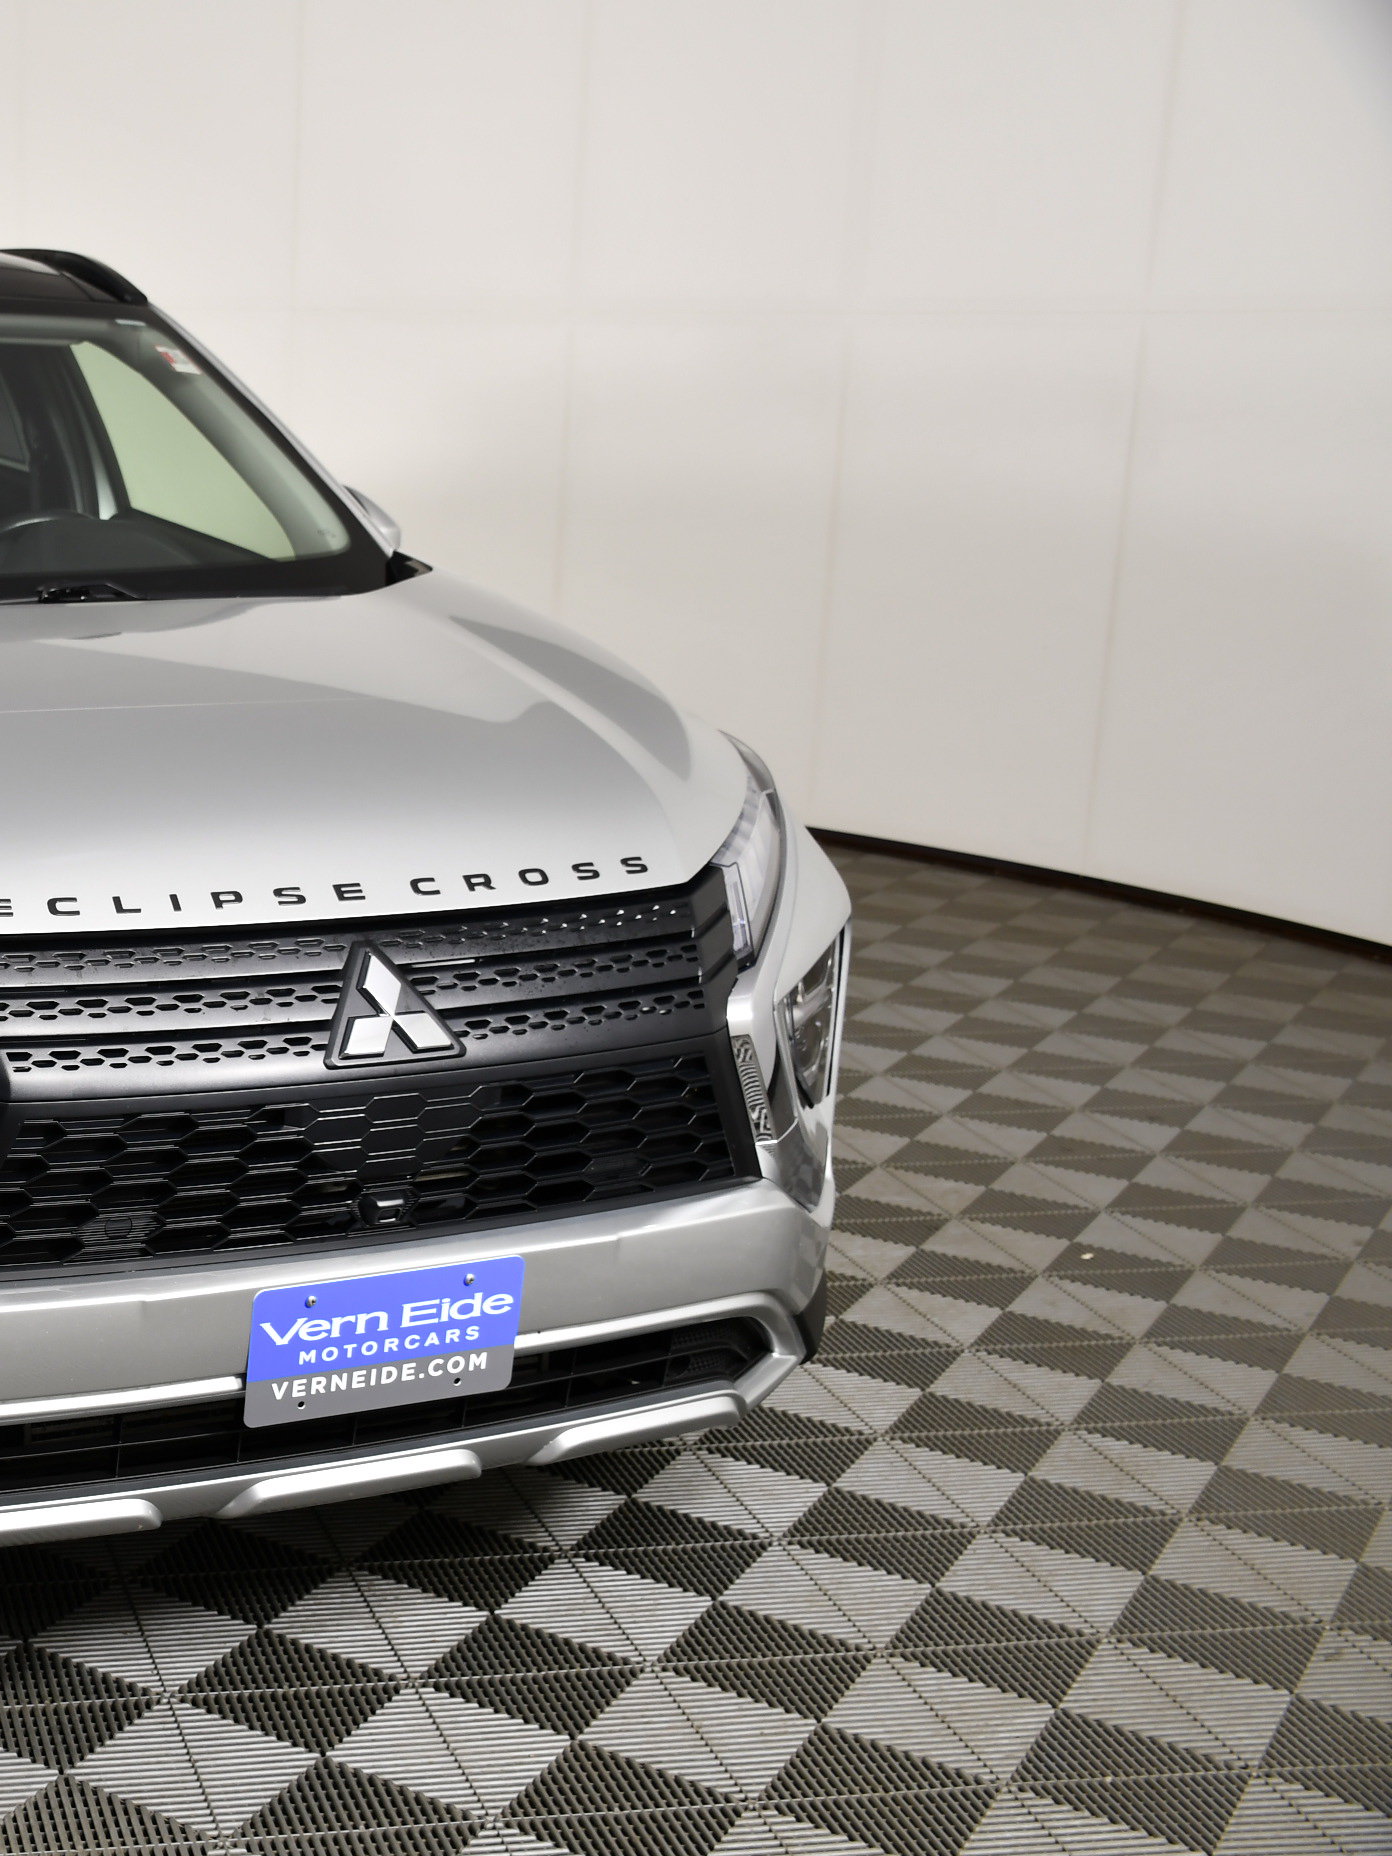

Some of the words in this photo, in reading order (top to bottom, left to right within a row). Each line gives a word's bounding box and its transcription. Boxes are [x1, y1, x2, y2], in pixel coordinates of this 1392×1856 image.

[409, 856, 649, 896] CROSS
[260, 1310, 389, 1346] Vern
[399, 1292, 514, 1328] Eide
[298, 1325, 481, 1365] MOTORCARS
[271, 1352, 488, 1401] VERNEIDE.COM
